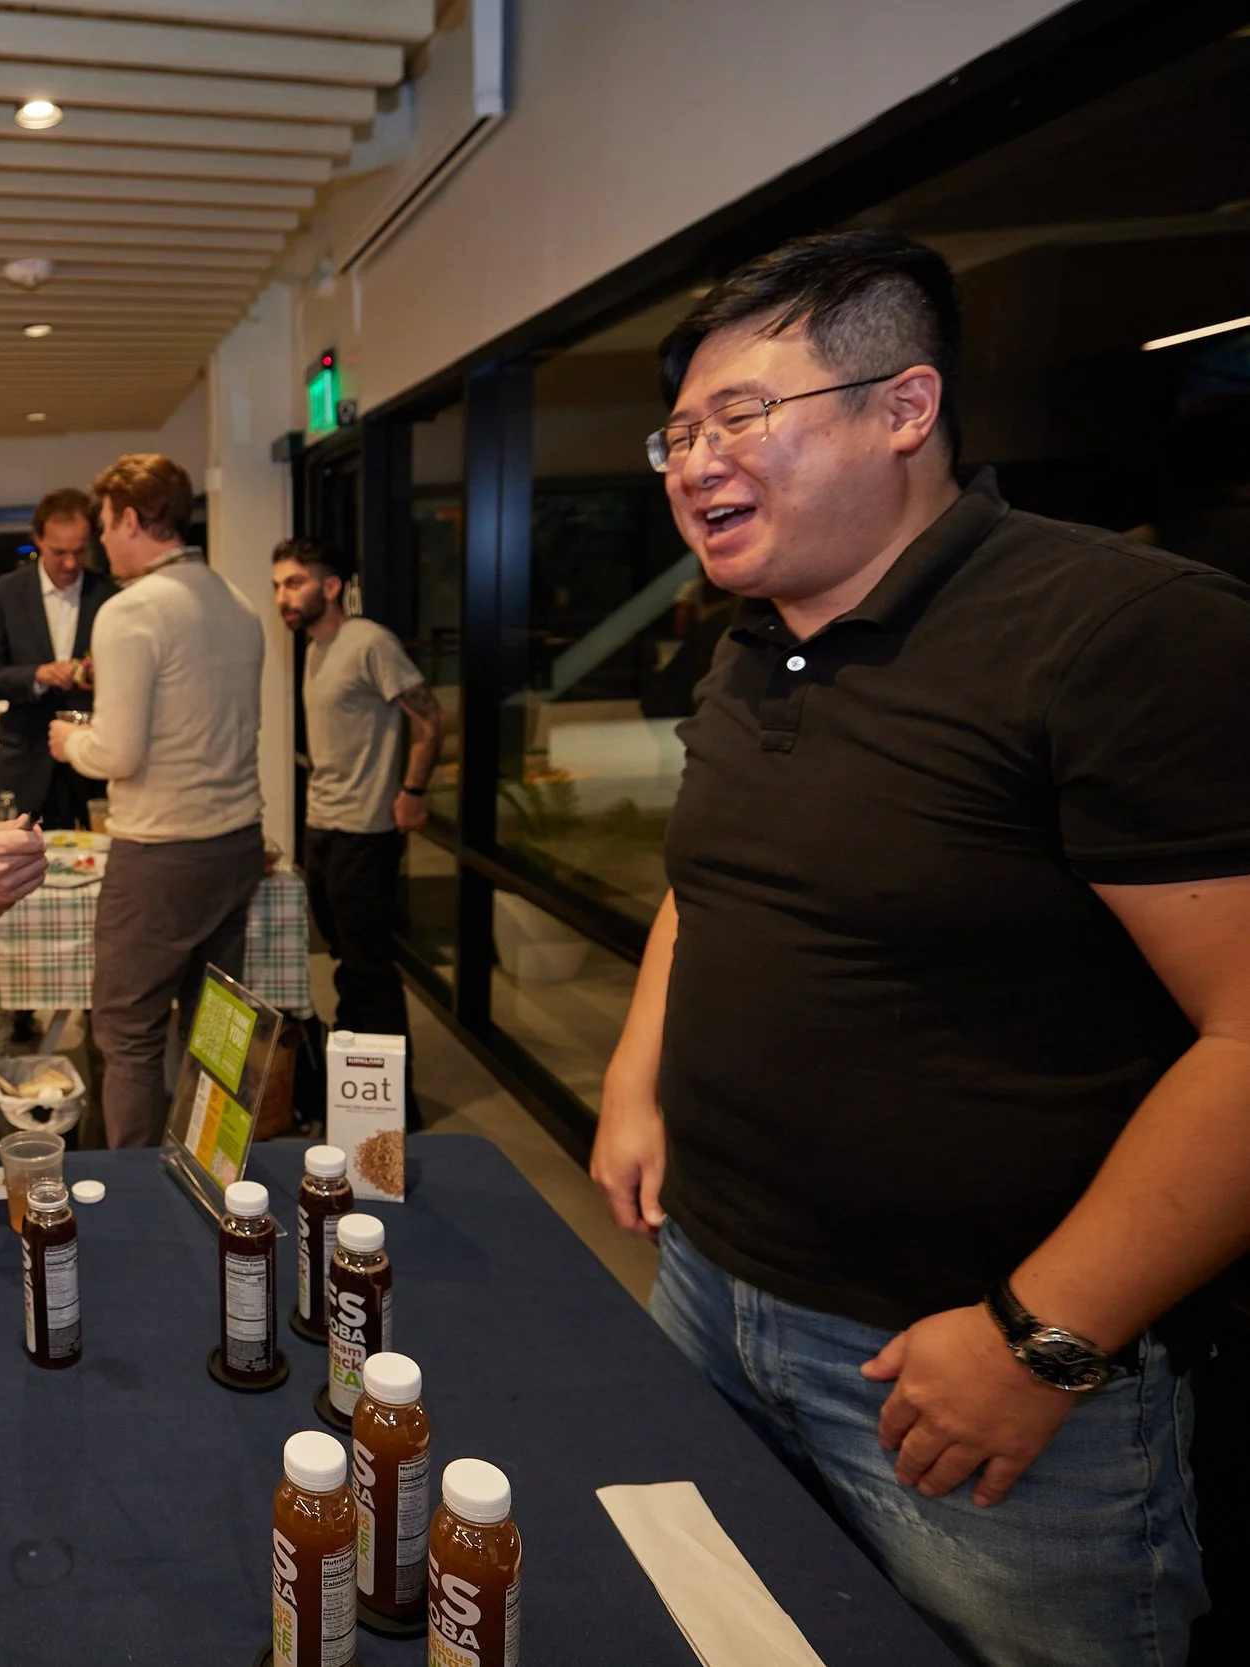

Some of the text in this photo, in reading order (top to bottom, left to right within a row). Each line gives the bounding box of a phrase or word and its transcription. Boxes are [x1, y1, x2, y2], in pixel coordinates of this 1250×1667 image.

[347, 1057, 384, 1066] KIRKLAND
[341, 1077, 391, 1102] oat
[323, 1576, 350, 1588] Calories
